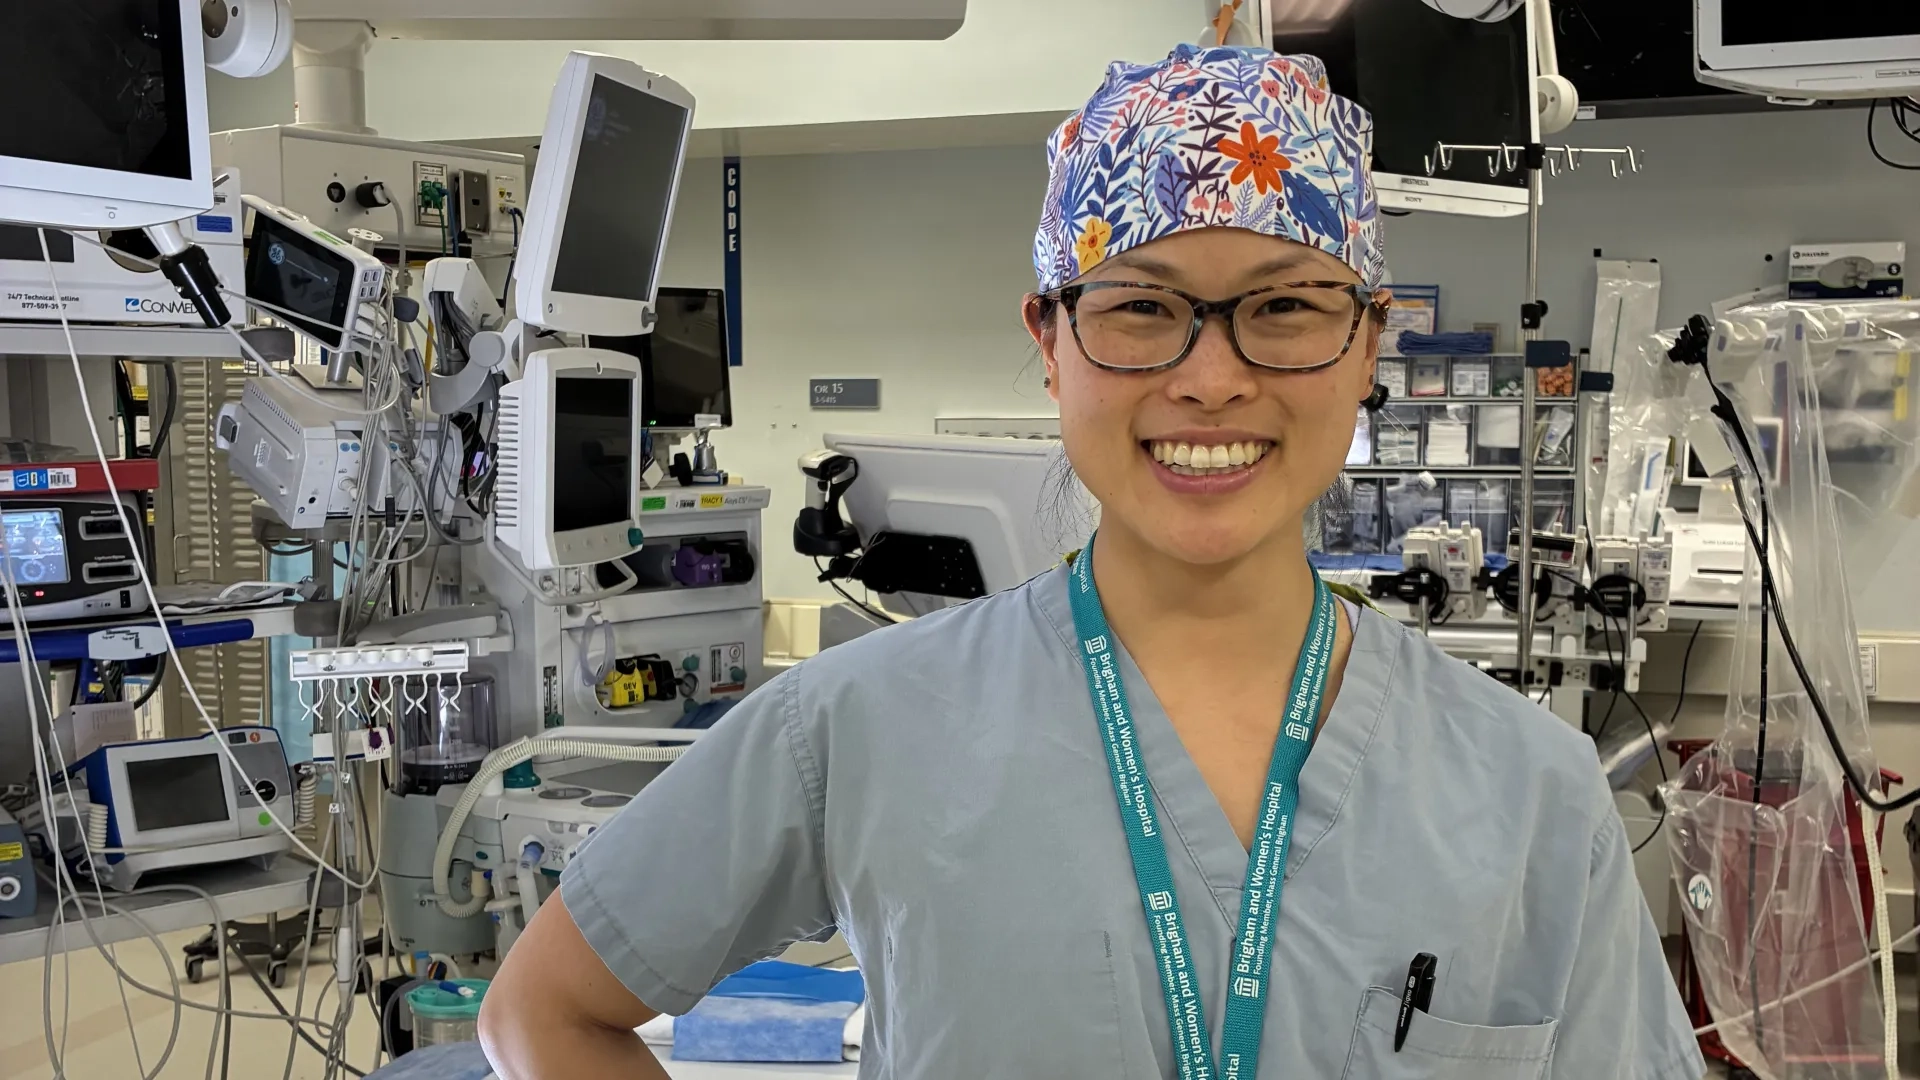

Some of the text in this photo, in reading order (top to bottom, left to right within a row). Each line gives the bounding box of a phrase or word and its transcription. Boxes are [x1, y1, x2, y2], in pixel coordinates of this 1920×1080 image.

[727, 167, 737, 252] CODE
[21, 302, 67, 310] 877-509-397
[24, 293, 55, 301] Technical
[814, 382, 844, 394] OR 15
[1290, 611, 1326, 720] Brigham and Women's
[1304, 694, 1320, 724] Founding
[1319, 651, 1329, 667] Mass
[1324, 626, 1334, 651] General
[1090, 657, 1102, 690] Founding
[1107, 723, 1116, 742] Mass
[1112, 743, 1124, 773] General
[1119, 774, 1131, 806] Brigham
[1100, 652, 1156, 837] Brigham and Women's Hospital
[1237, 781, 1282, 973] Brigham and Women's Hospital
[1253, 814, 1288, 975] Founding Member, Mass General Brigham
[1154, 915, 1168, 954] Founding
[1163, 955, 1176, 993] Member,
[1171, 994, 1181, 1017] Mass
[1176, 1018, 1188, 1052] General
[1164, 912, 1186, 968] Brigham
[1178, 971, 1194, 997] and
[1184, 999, 1206, 1064] Women's
